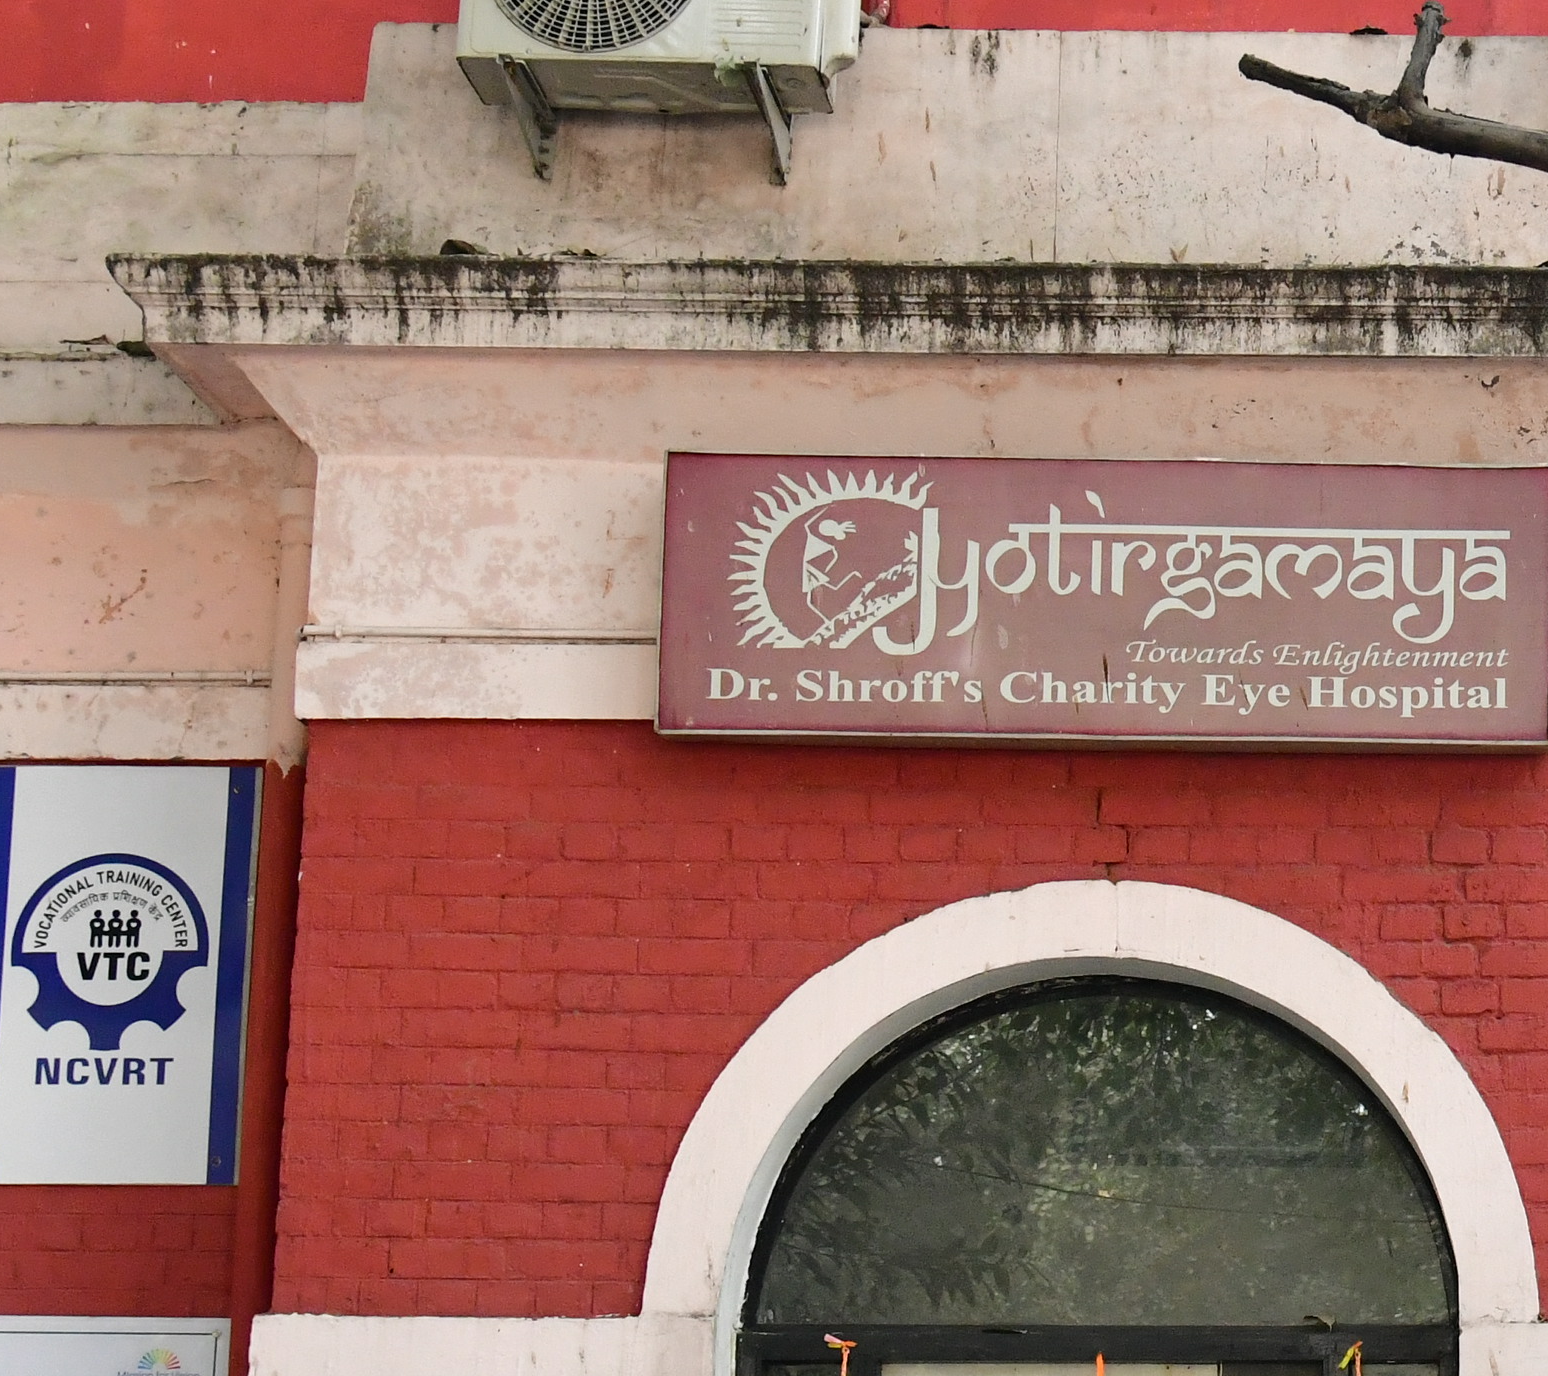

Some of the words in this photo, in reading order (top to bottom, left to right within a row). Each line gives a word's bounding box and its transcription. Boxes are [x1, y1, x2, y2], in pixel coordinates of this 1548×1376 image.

[874, 491, 1511, 656] Jyotirgamaya
[1126, 639, 1264, 664] Towards
[1273, 642, 1508, 674] Enlightenment
[706, 669, 777, 700] Dr.
[796, 670, 981, 702] Shroff's
[1000, 672, 1185, 713] Charity
[1201, 675, 1290, 715] Eye
[1307, 677, 1508, 717] Hospital
[34, 876, 94, 949] VOCATIONAL
[97, 870, 162, 897] TRAINING
[161, 894, 188, 948] CENTER
[77, 952, 150, 981] VTC
[35, 1058, 174, 1085] NCVRT
